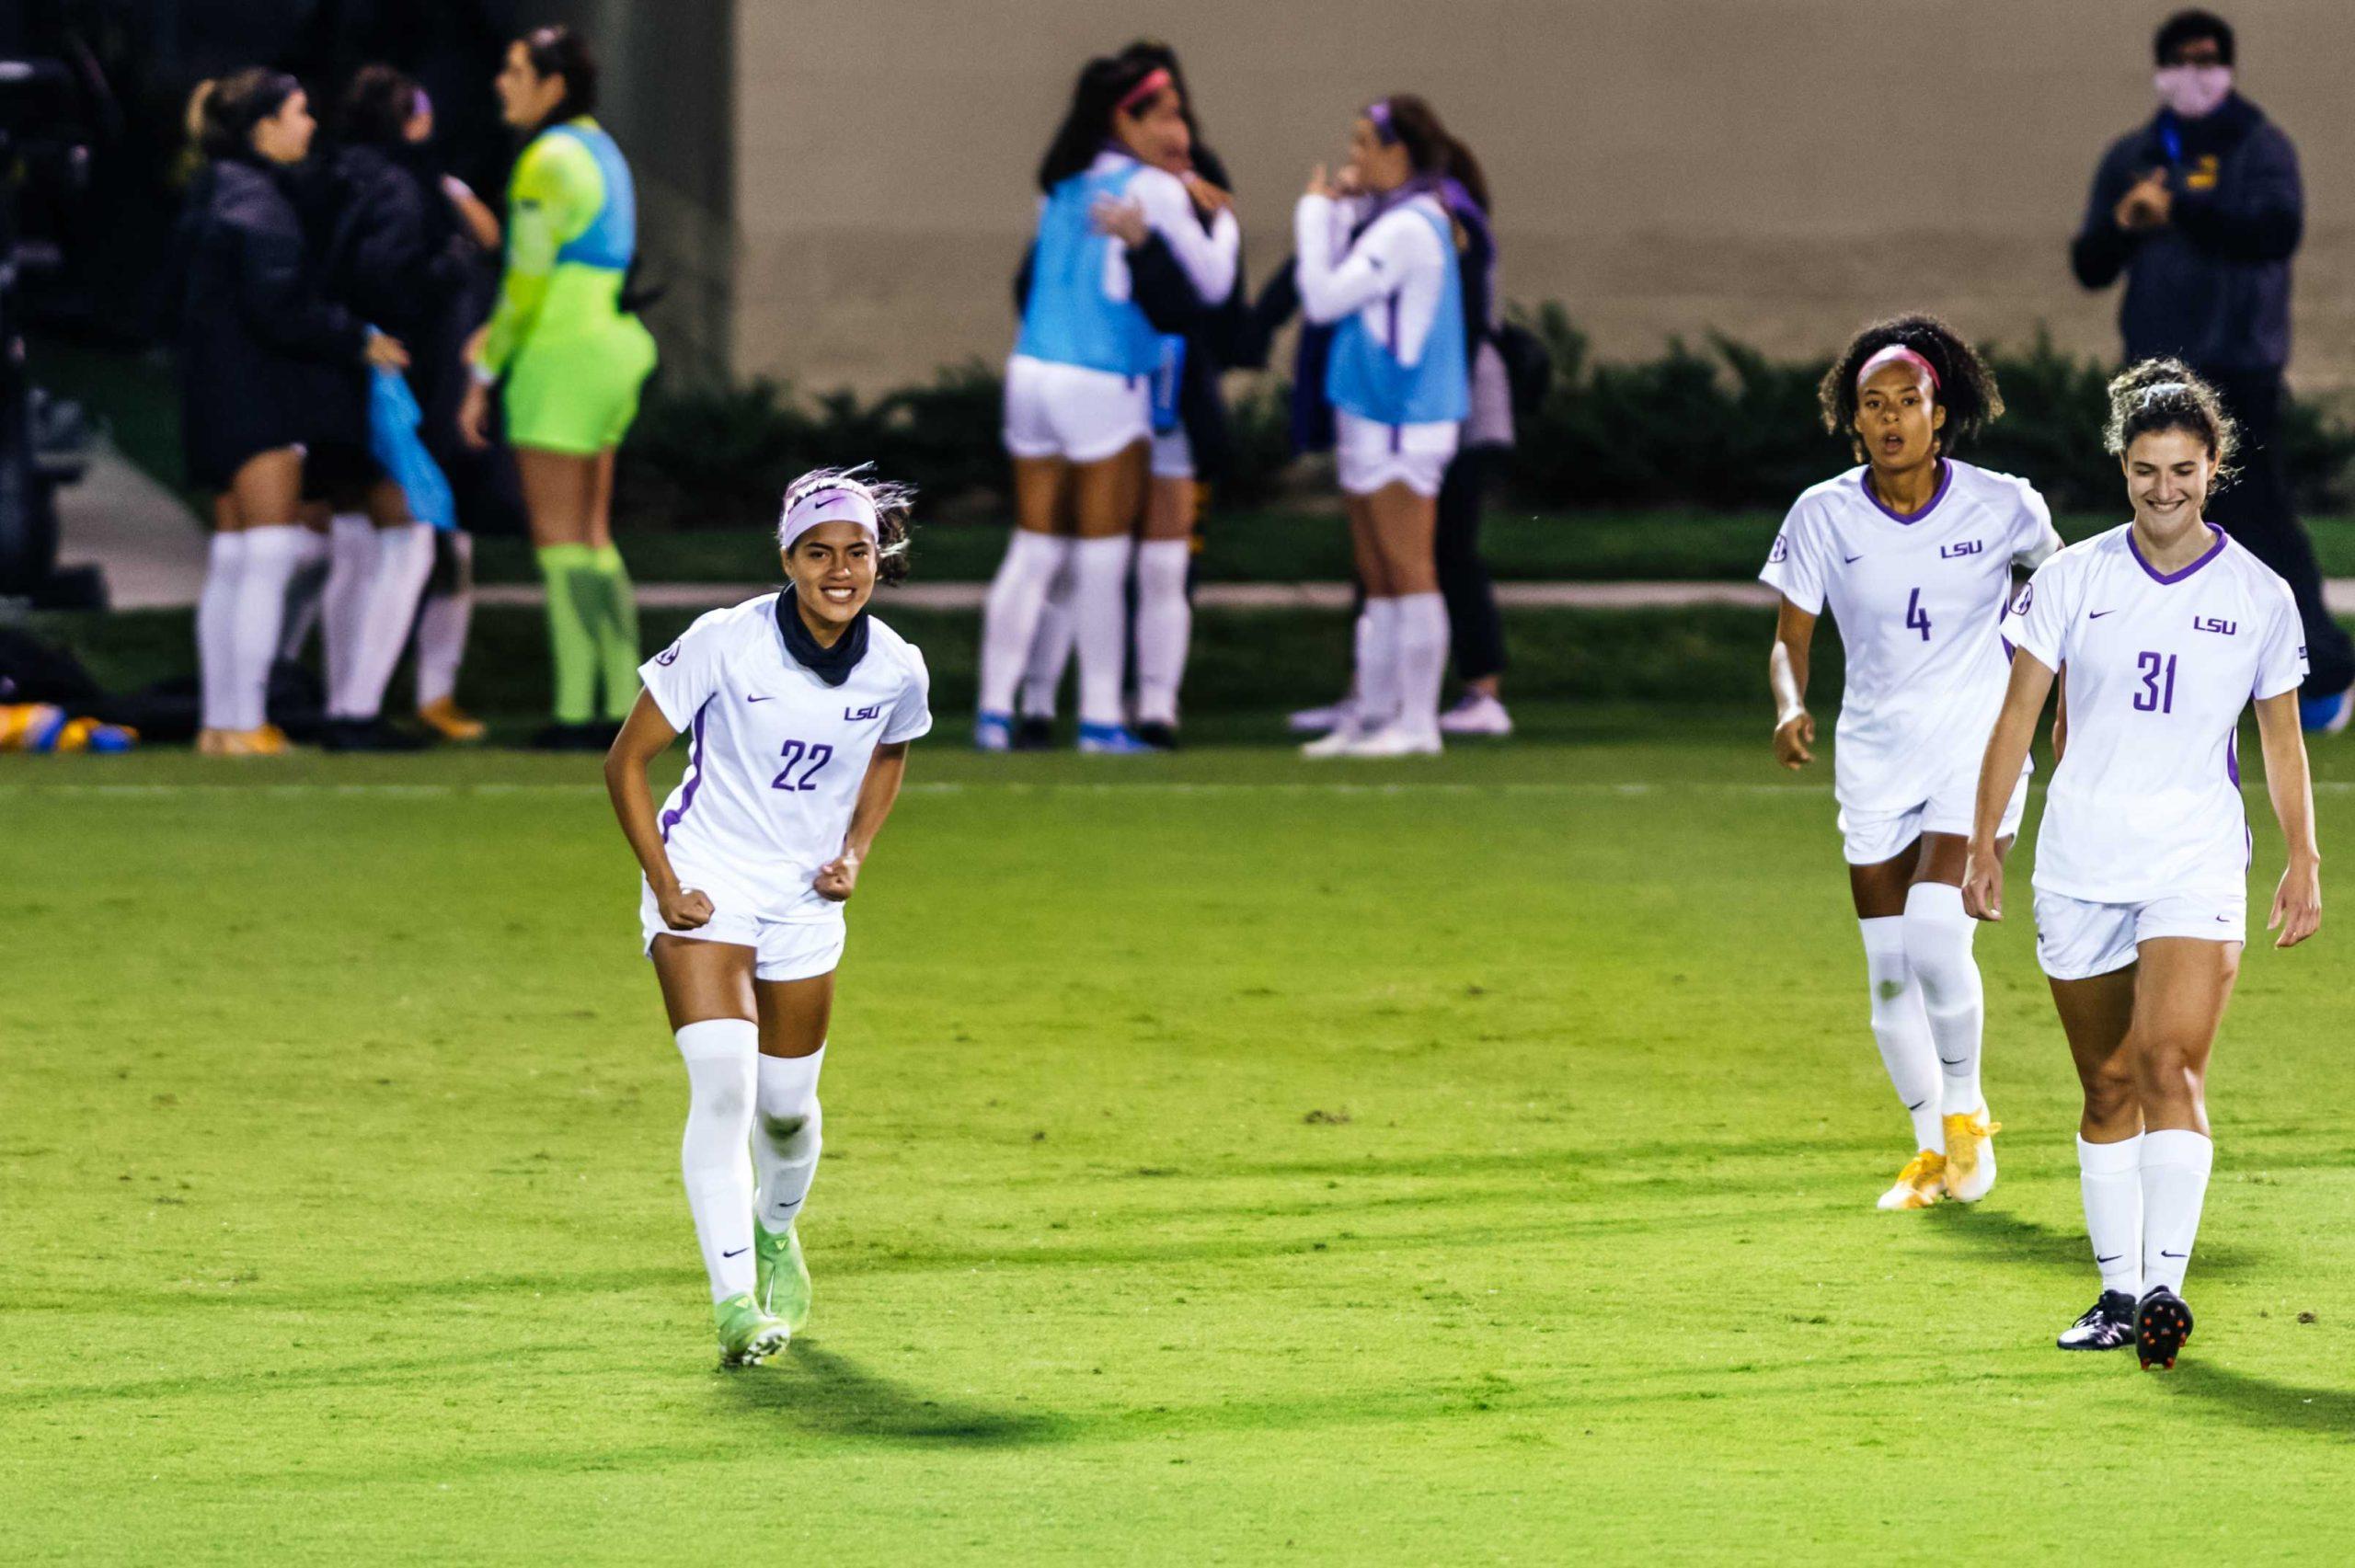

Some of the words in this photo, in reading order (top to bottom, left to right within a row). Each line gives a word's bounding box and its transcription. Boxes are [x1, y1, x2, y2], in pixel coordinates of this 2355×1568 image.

[1940, 540, 1982, 559] LSU
[1906, 588, 1932, 641] 4
[2193, 616, 2236, 635] LSU
[2132, 651, 2177, 714] 31
[844, 706, 880, 721] LSU
[771, 739, 833, 792] 22
